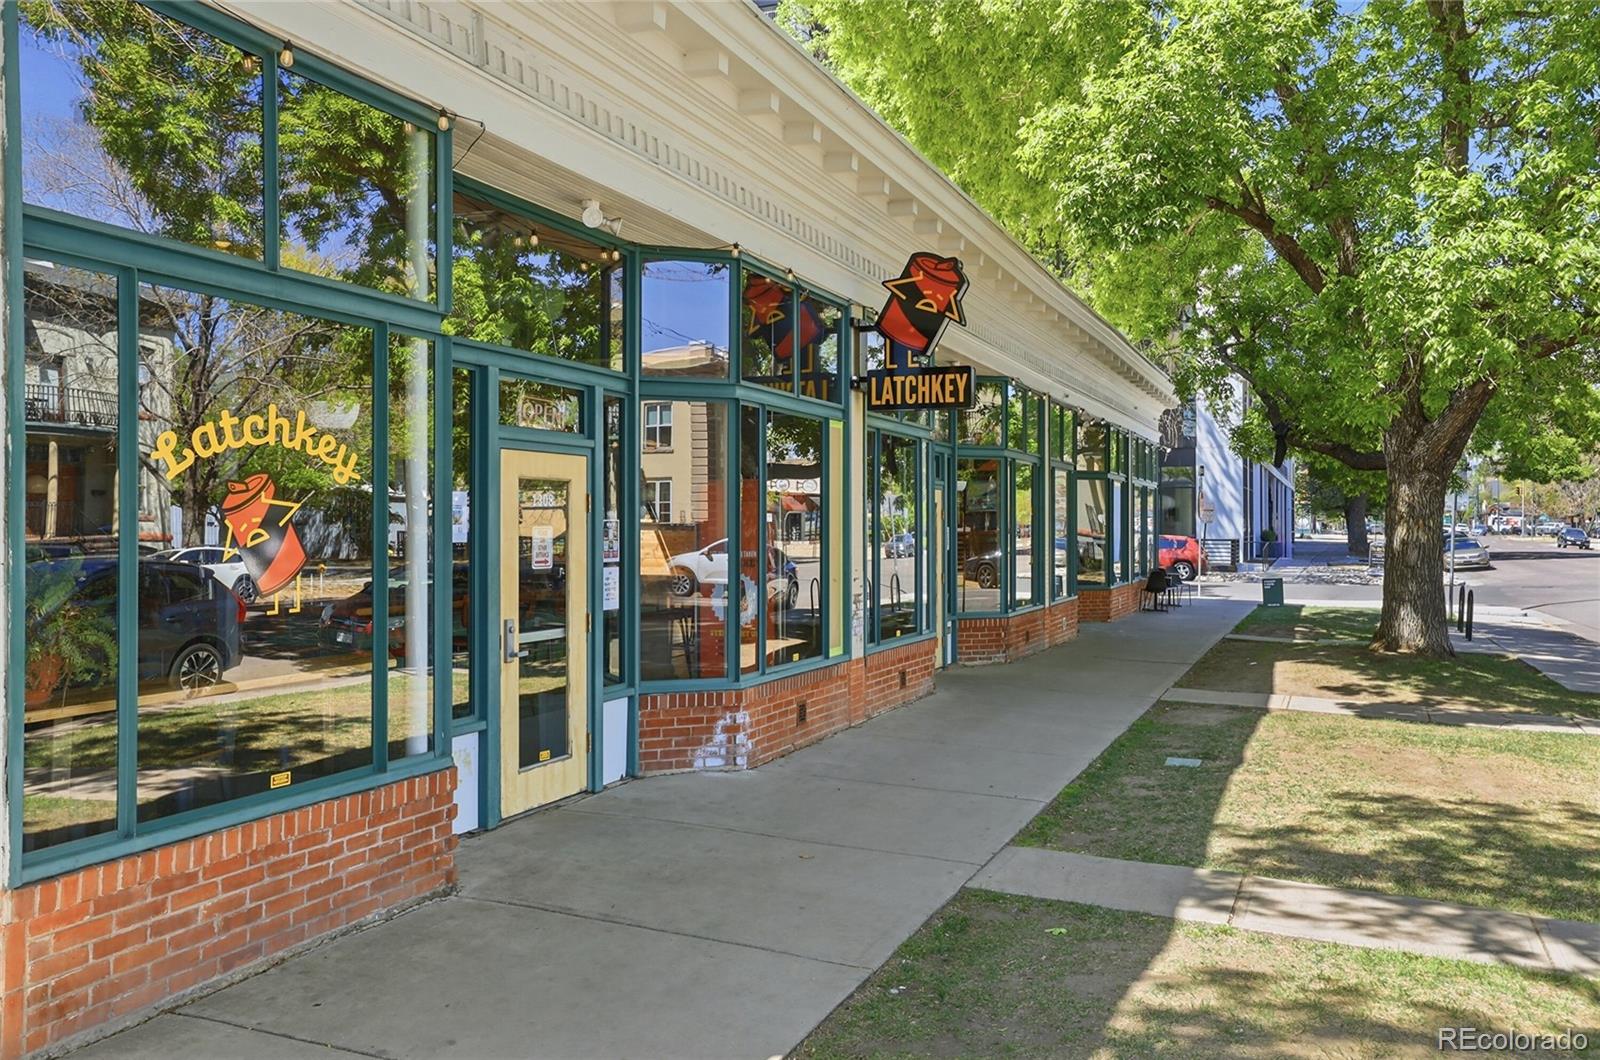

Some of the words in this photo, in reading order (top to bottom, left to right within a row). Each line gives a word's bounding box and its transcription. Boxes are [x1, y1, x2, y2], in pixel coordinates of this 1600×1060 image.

[871, 373, 968, 405] LATCHKEY
[522, 401, 565, 427] OPEN
[150, 403, 361, 485] Latchkey
